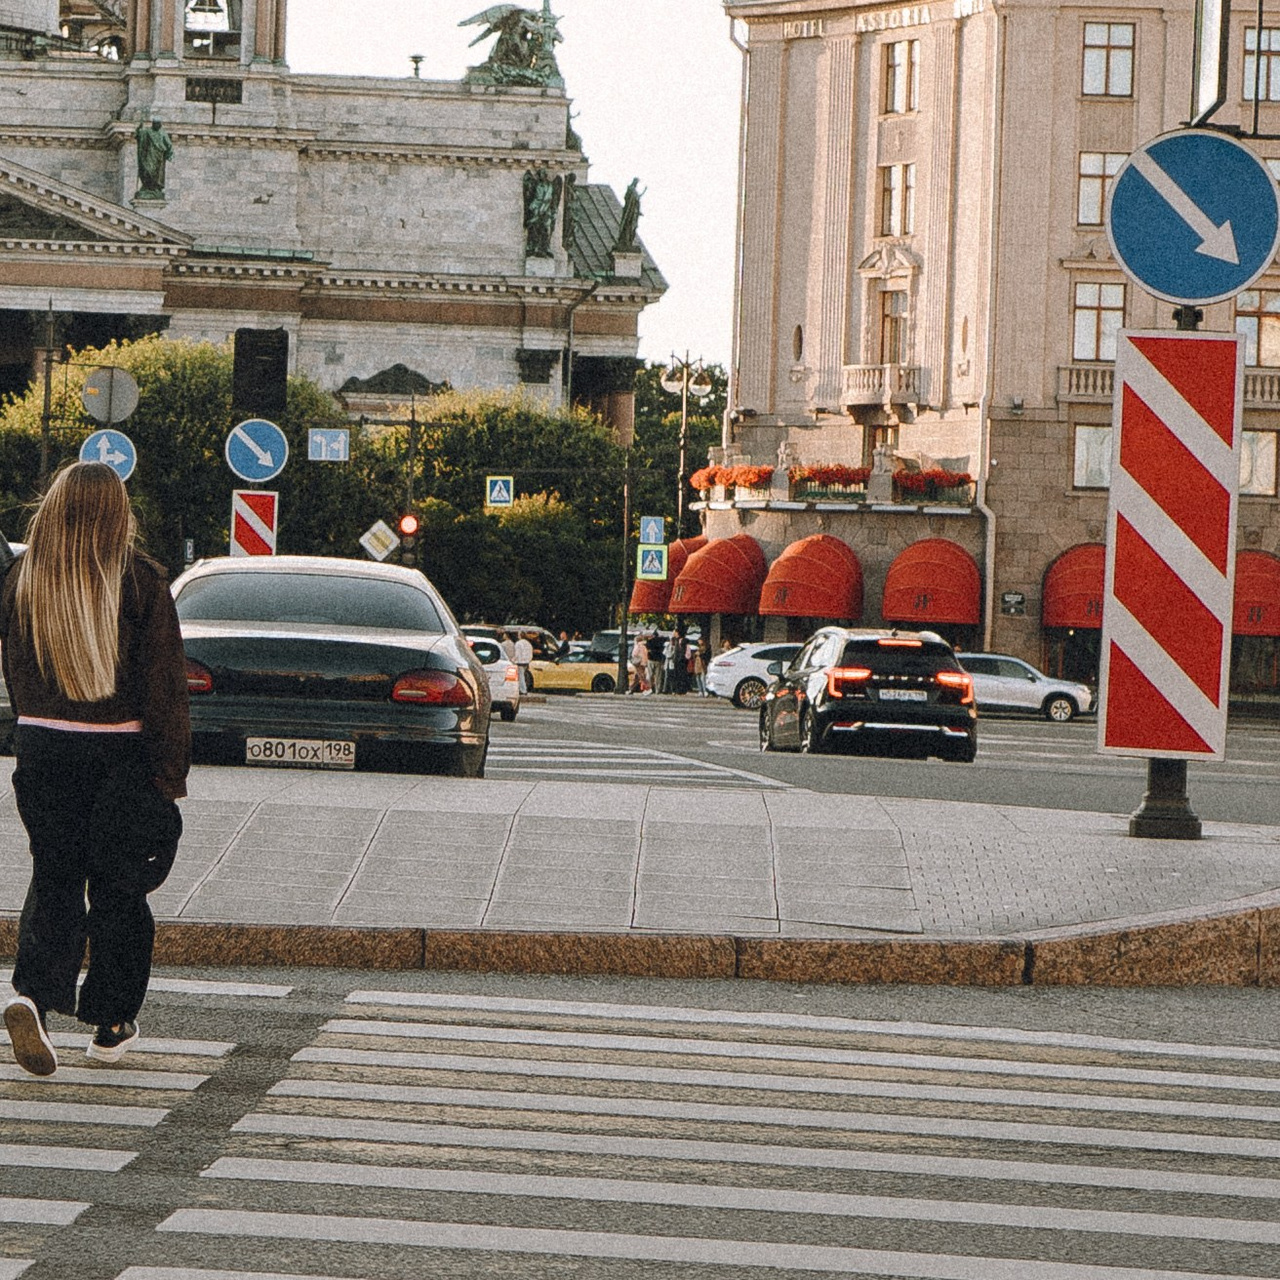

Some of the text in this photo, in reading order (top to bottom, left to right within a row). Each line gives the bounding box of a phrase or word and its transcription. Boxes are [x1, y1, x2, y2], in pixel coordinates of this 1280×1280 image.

[784, 19, 825, 38] HOTEL
[856, 4, 931, 32] ASTORIA
[325, 743, 351, 756] 198
